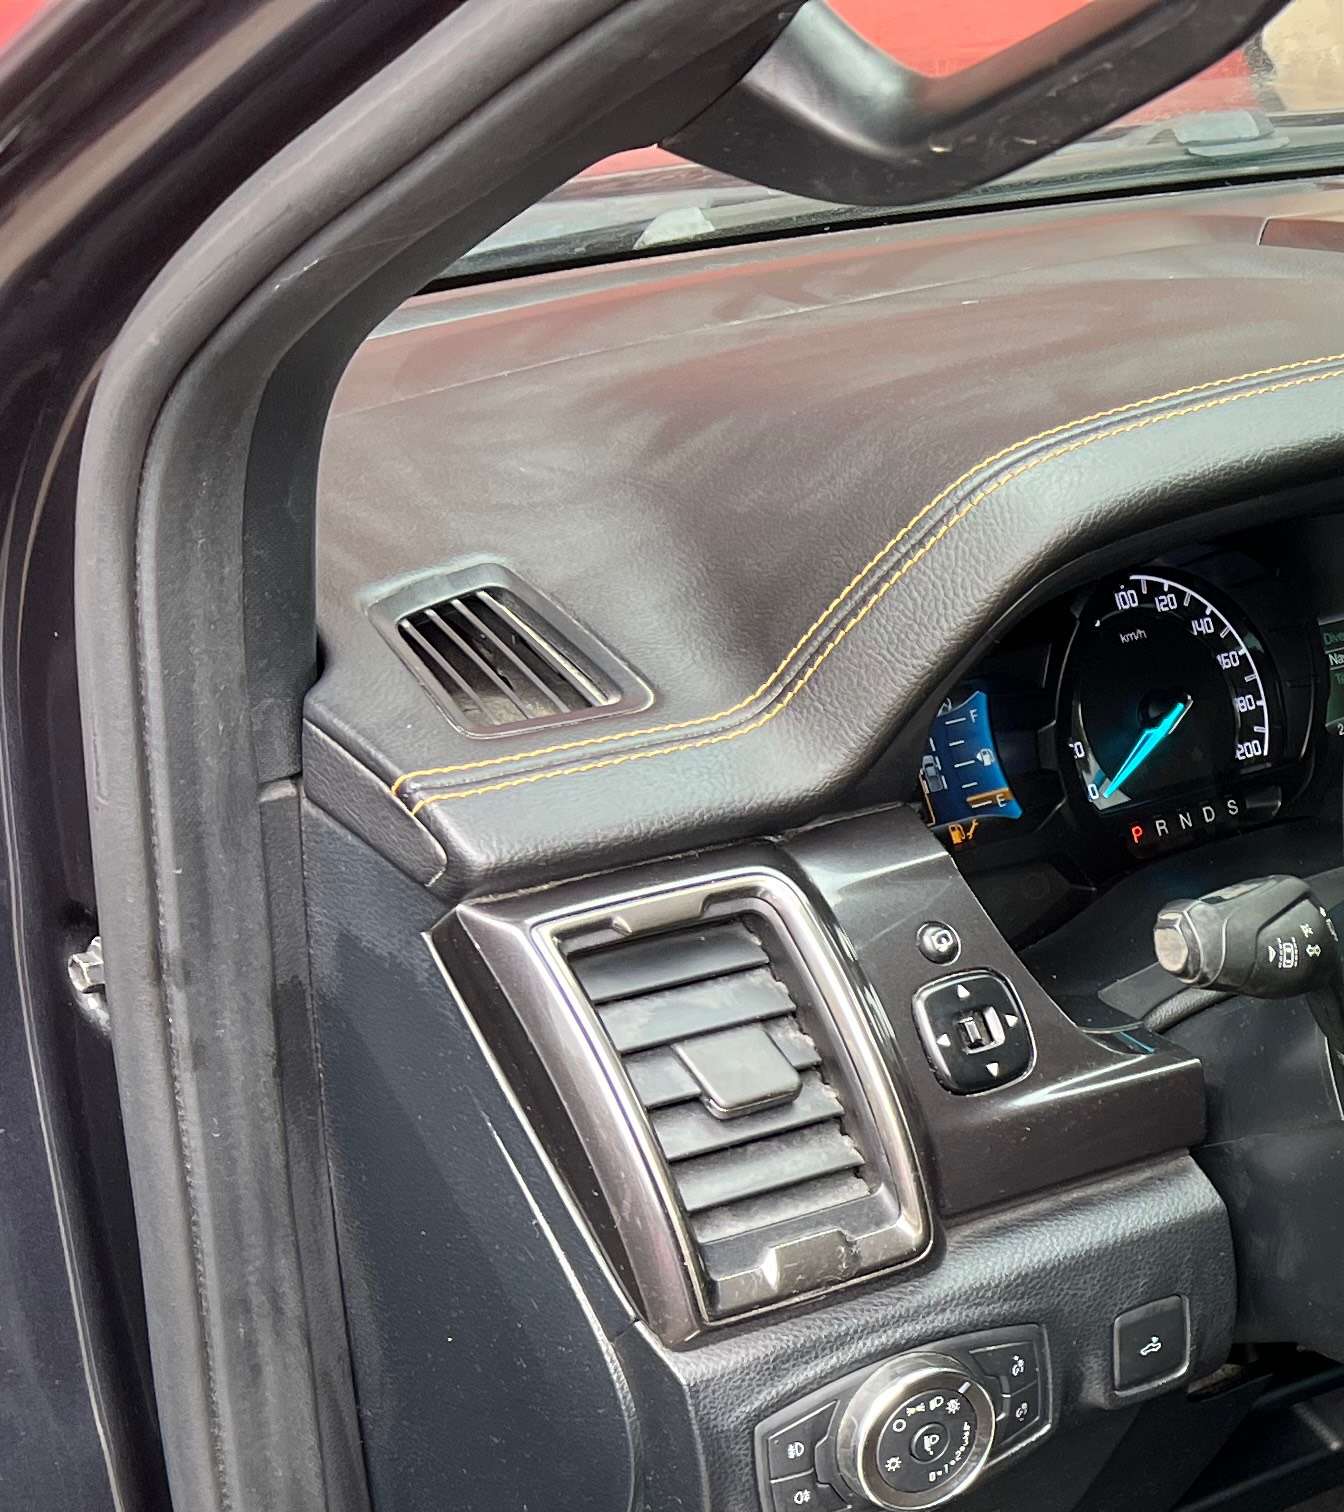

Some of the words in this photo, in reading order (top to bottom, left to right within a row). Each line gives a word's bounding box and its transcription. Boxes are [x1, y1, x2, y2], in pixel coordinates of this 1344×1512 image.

[1114, 589, 1139, 611] 100
[1155, 593, 1178, 612] 120
[1119, 628, 1147, 644] km/h
[1191, 617, 1215, 636] 140
[1216, 651, 1240, 670] 160
[1235, 740, 1262, 760] 200
[1131, 825, 1143, 844] P
[1155, 819, 1169, 837] R
[1179, 812, 1193, 830] N
[1202, 806, 1216, 823] D
[1227, 799, 1239, 815] S
